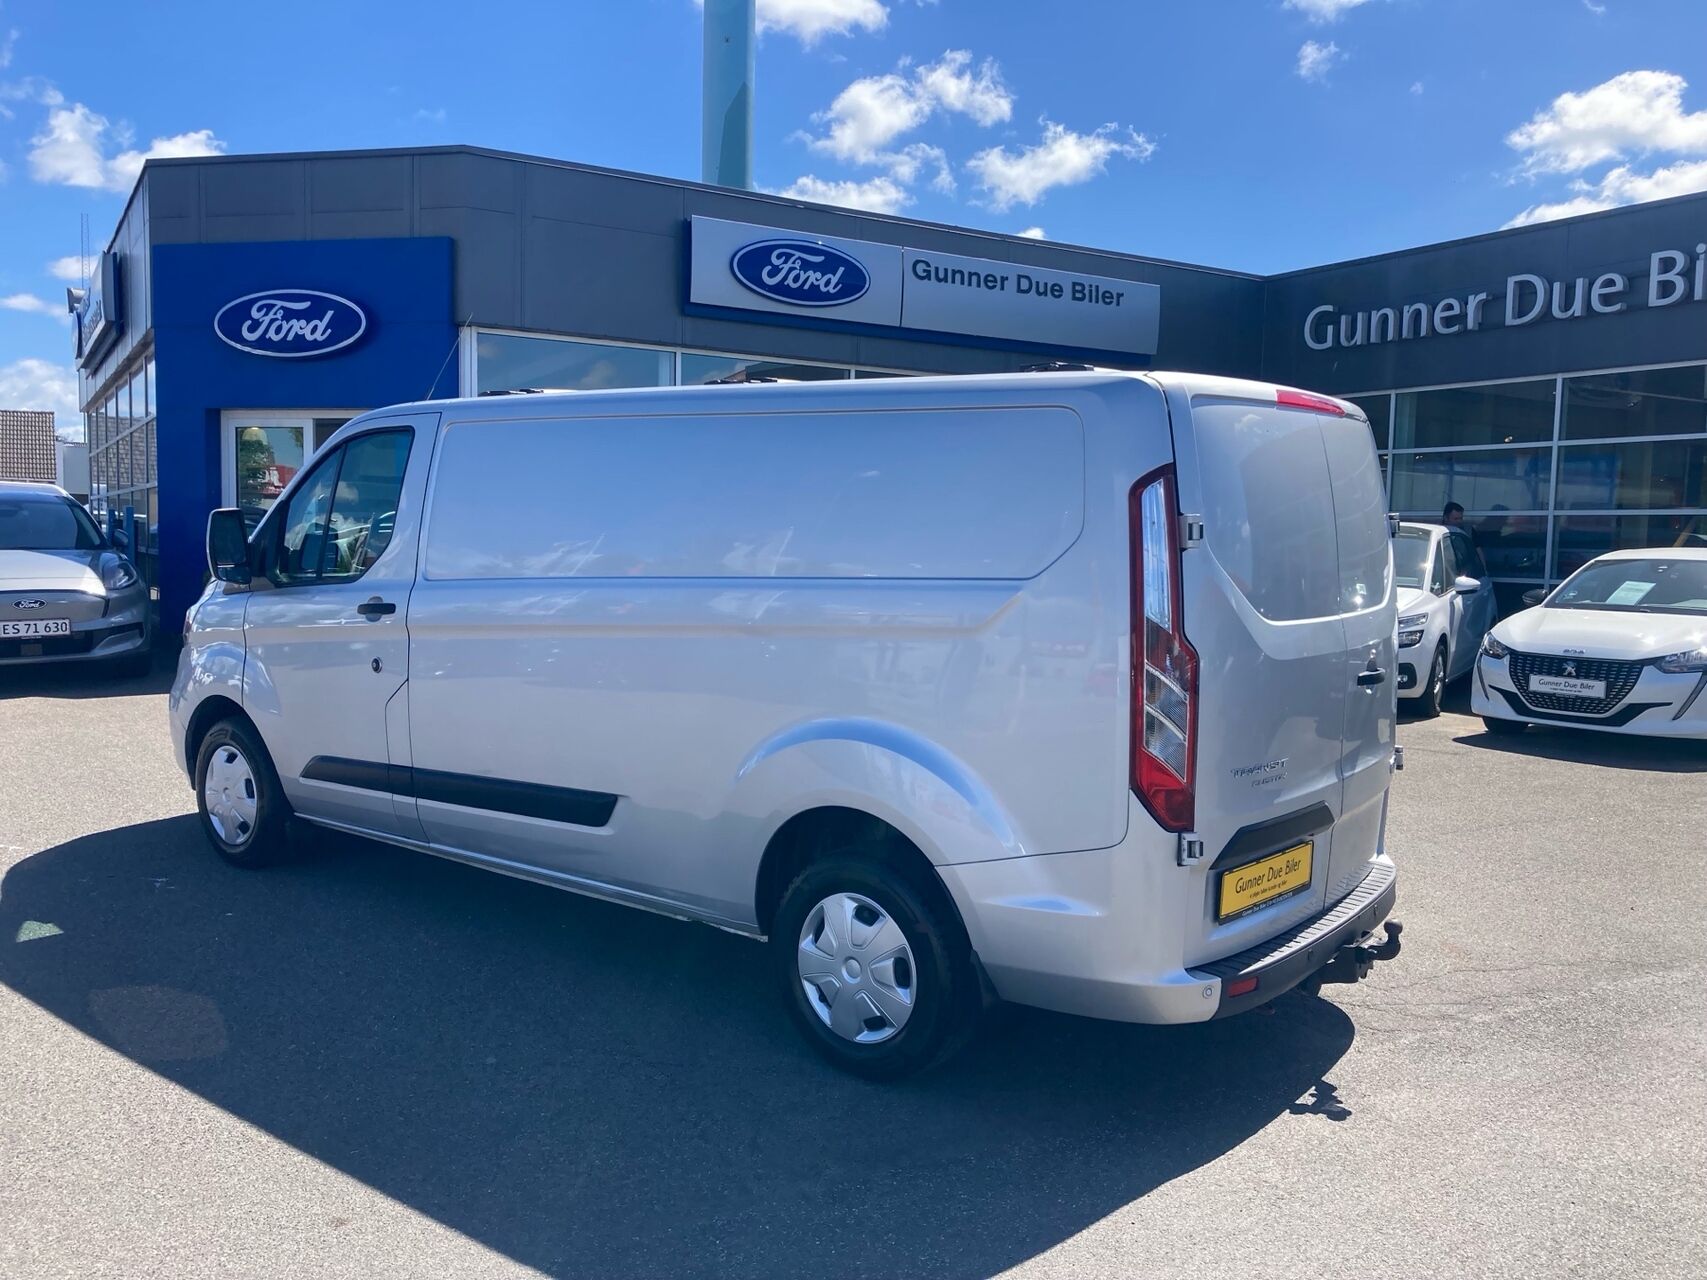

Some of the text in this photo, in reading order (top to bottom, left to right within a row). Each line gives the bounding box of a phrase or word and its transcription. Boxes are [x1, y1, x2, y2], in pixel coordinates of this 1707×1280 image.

[761, 248, 845, 294] Ford
[911, 258, 1124, 307] Gunner Due Biler
[1304, 243, 1707, 351] Gunner Due Bi
[241, 299, 334, 342] Ford
[2, 621, 68, 635] ES 71 630
[1538, 678, 1562, 687] Gunner
[1563, 681, 1578, 689] Due
[1580, 683, 1596, 691] Biler
[1235, 872, 1266, 894] Gunner
[1267, 866, 1283, 882] Due
[1284, 858, 1302, 875] Biler
